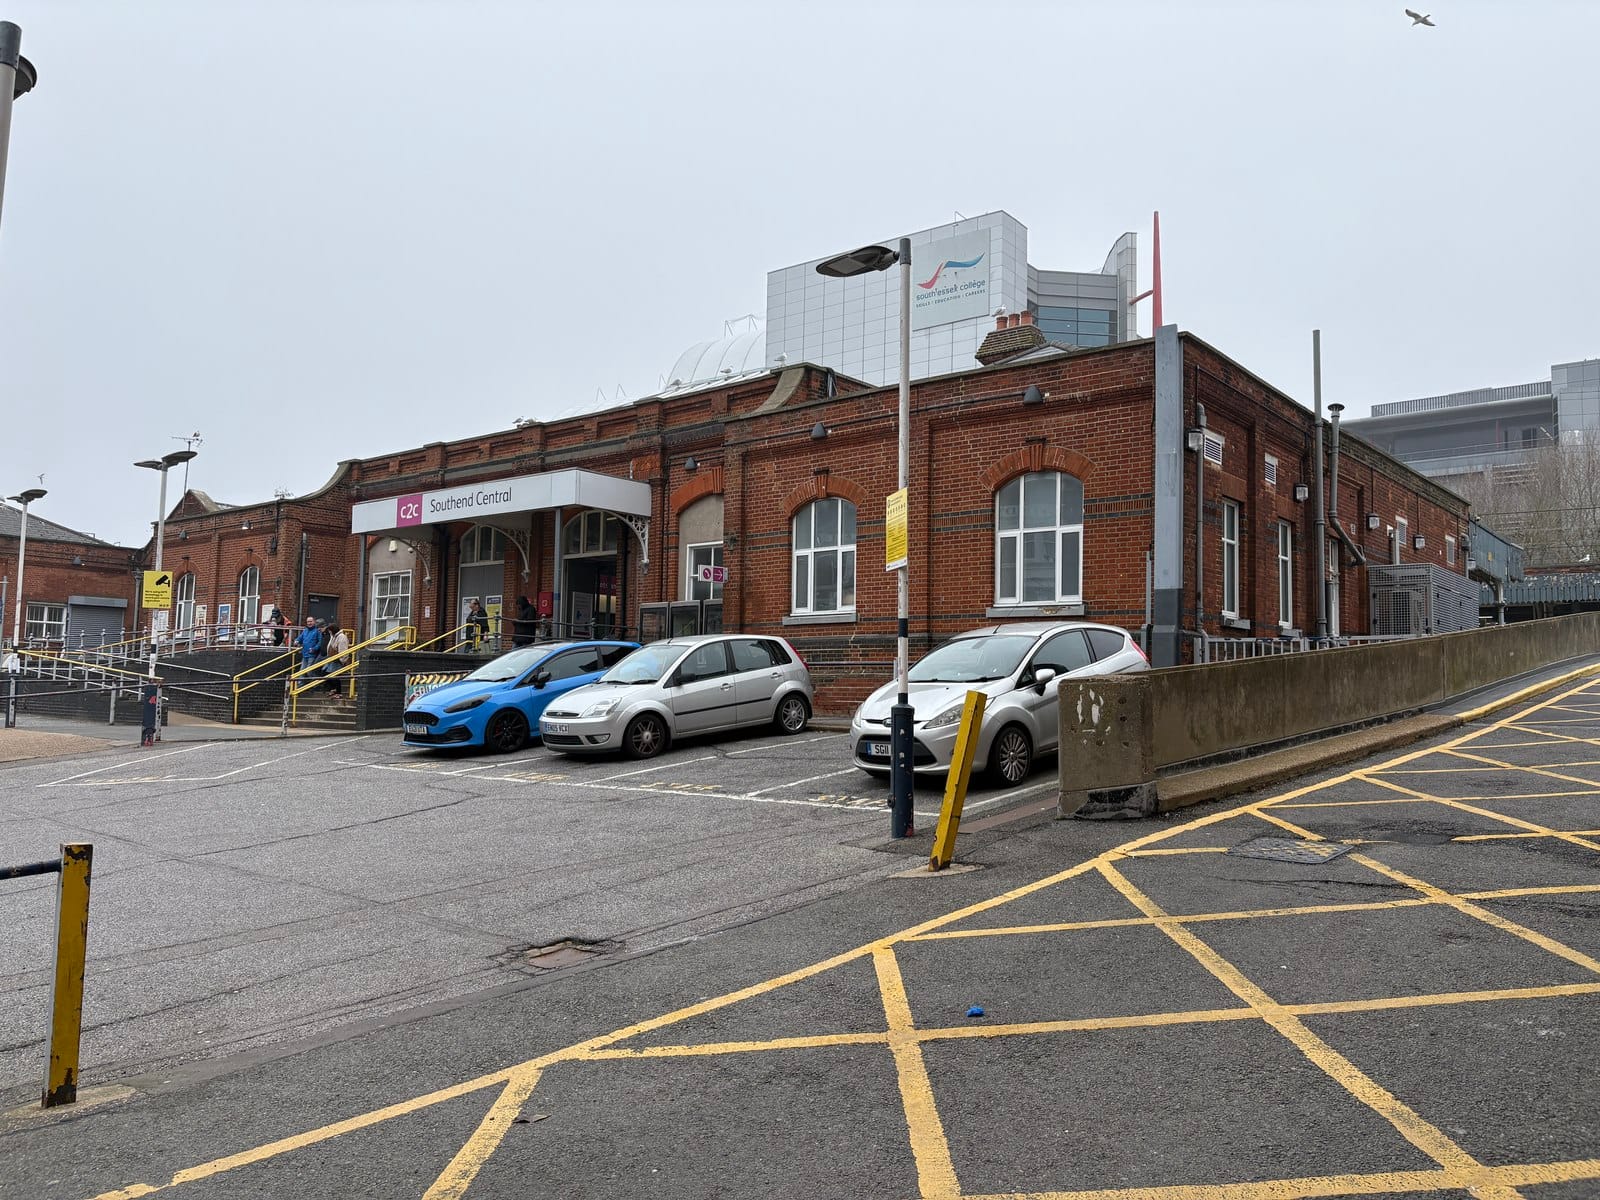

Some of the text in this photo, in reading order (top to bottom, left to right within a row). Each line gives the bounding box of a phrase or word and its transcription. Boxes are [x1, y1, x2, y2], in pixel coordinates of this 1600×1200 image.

[916, 290, 936, 300] south
[960, 280, 985, 291] college
[430, 487, 512, 513] Southend Central
[400, 503, 419, 519] c2c
